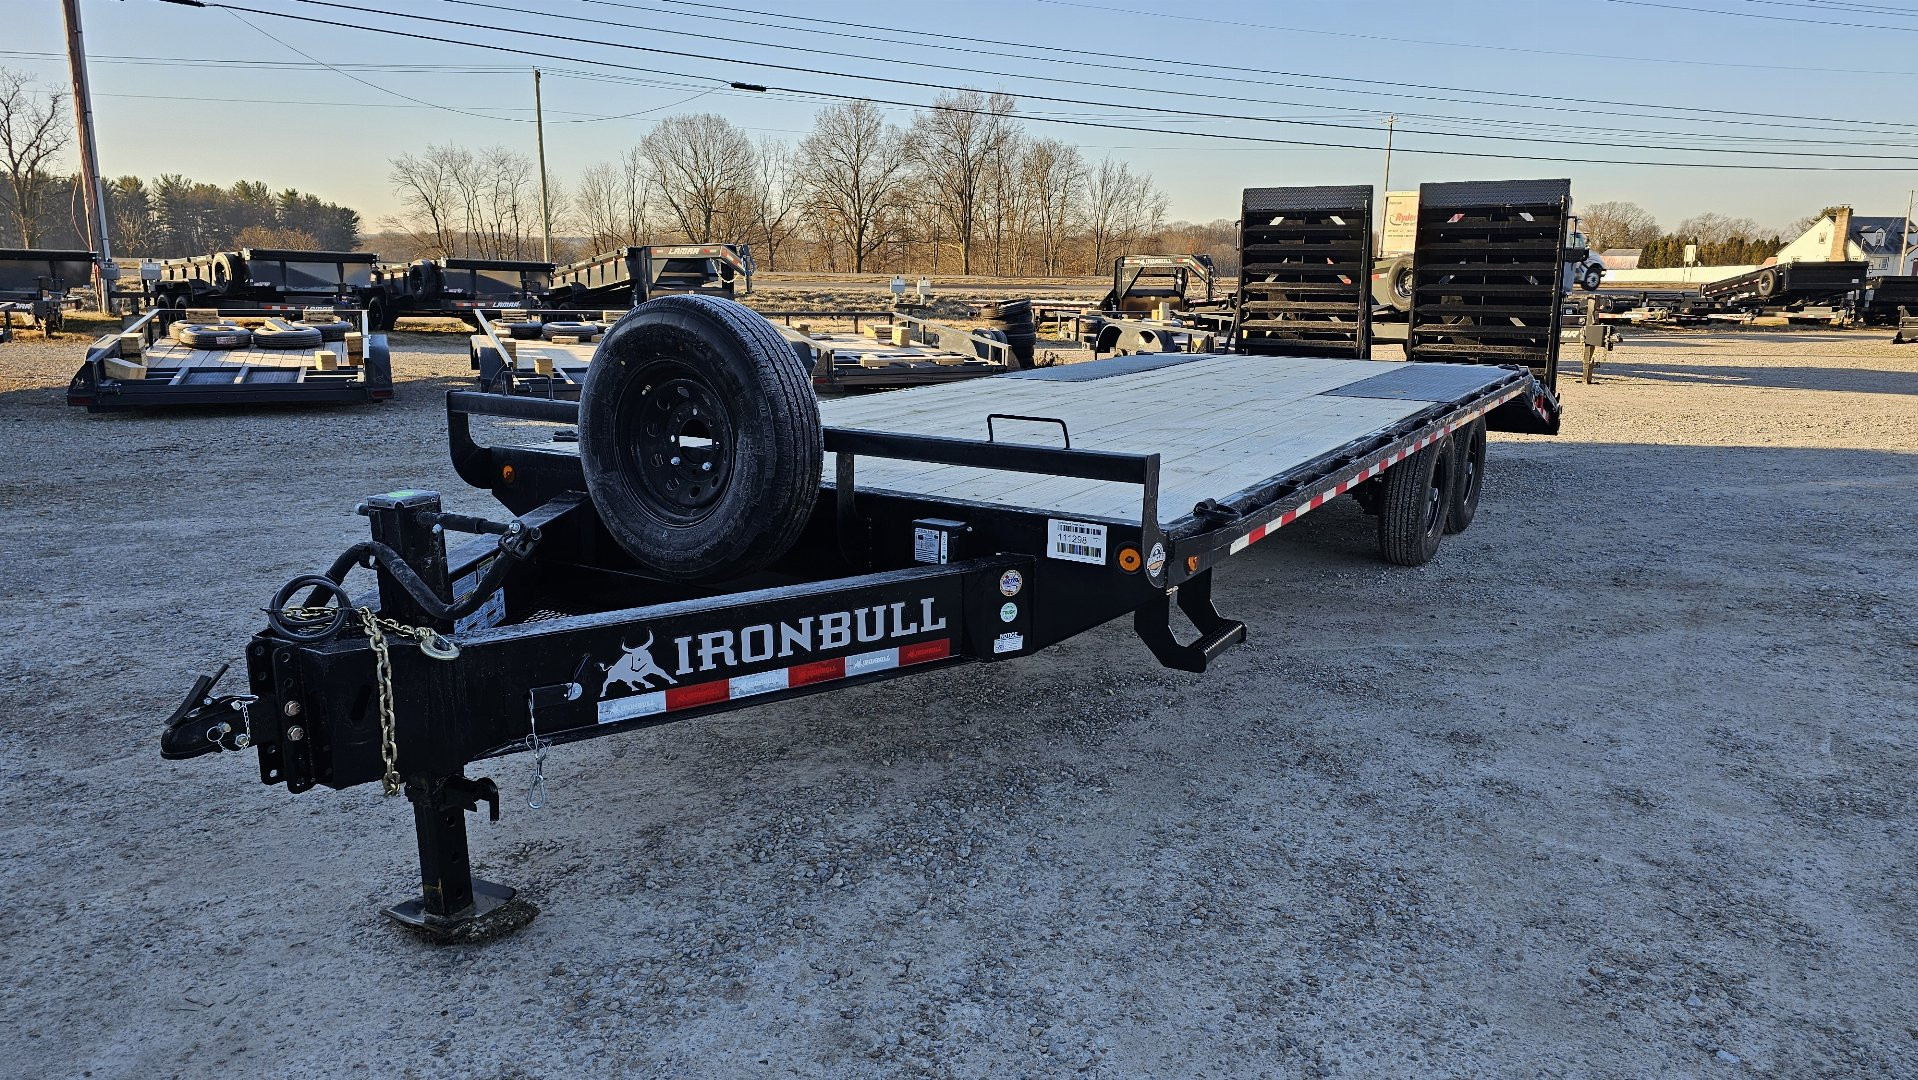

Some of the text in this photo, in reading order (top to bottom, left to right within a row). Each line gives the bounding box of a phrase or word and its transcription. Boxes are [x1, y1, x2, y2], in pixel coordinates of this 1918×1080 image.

[1057, 533, 1088, 545] 111298
[674, 597, 947, 676] IRONBULL
[620, 699, 656, 711] IRONBULL
